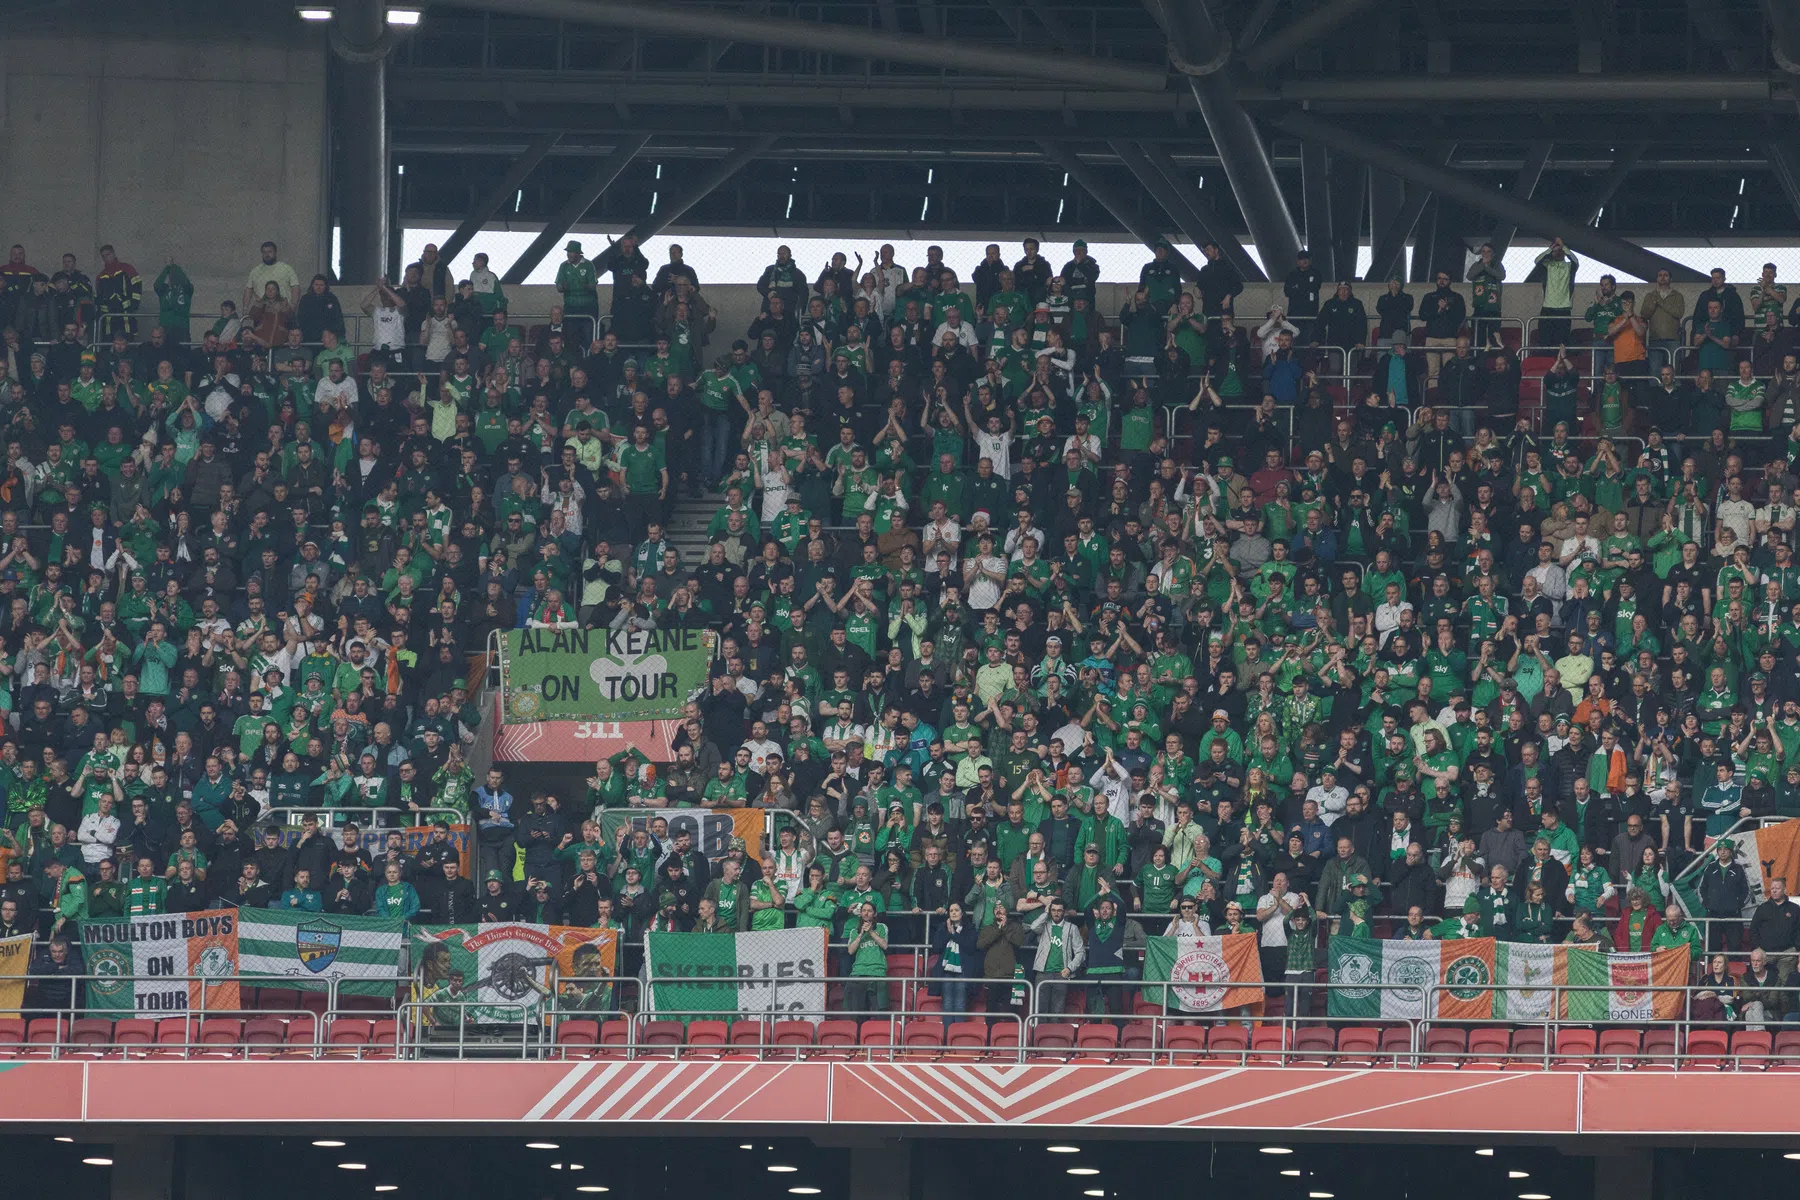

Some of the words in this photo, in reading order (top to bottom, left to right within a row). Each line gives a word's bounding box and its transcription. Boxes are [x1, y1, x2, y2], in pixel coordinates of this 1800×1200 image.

[707, 389, 724, 399] OPEL
[882, 509, 892, 520] 3
[381, 515, 391, 527] 3
[1203, 547, 1212, 560] 3
[776, 608, 790, 619] sky
[1617, 610, 1635, 620] sky
[519, 628, 589, 656] ALAN
[606, 628, 698, 655] KEANE
[943, 634, 957, 643] sky
[219, 664, 235, 673] sky
[1434, 664, 1449, 674] sky
[1521, 667, 1534, 676] sky
[1481, 672, 1492, 682] sky
[541, 675, 580, 701] ON
[605, 672, 678, 702] TOUR
[573, 721, 624, 739] 311
[1012, 765, 1022, 775] 15
[92, 791, 103, 799] sk
[1105, 789, 1119, 798] sky
[1260, 833, 1269, 844] 3
[1190, 870, 1205, 879] sky
[1450, 871, 1474, 880] OPEL
[1153, 876, 1160, 886] 11
[387, 896, 403, 906] sky
[718, 899, 734, 909] sky
[83, 920, 177, 944] MOULTON
[181, 916, 233, 939] BOYS
[468, 938, 484, 950] The
[484, 929, 513, 942] Thirsty
[515, 928, 544, 943] Gooner
[544, 940, 559, 952] Bar
[147, 956, 174, 976] ON
[1196, 953, 1227, 974] FOOTBALL
[657, 958, 815, 990] SKERRIES
[135, 990, 188, 1010] TOUR
[1602, 1008, 1661, 1020] GOONERS
